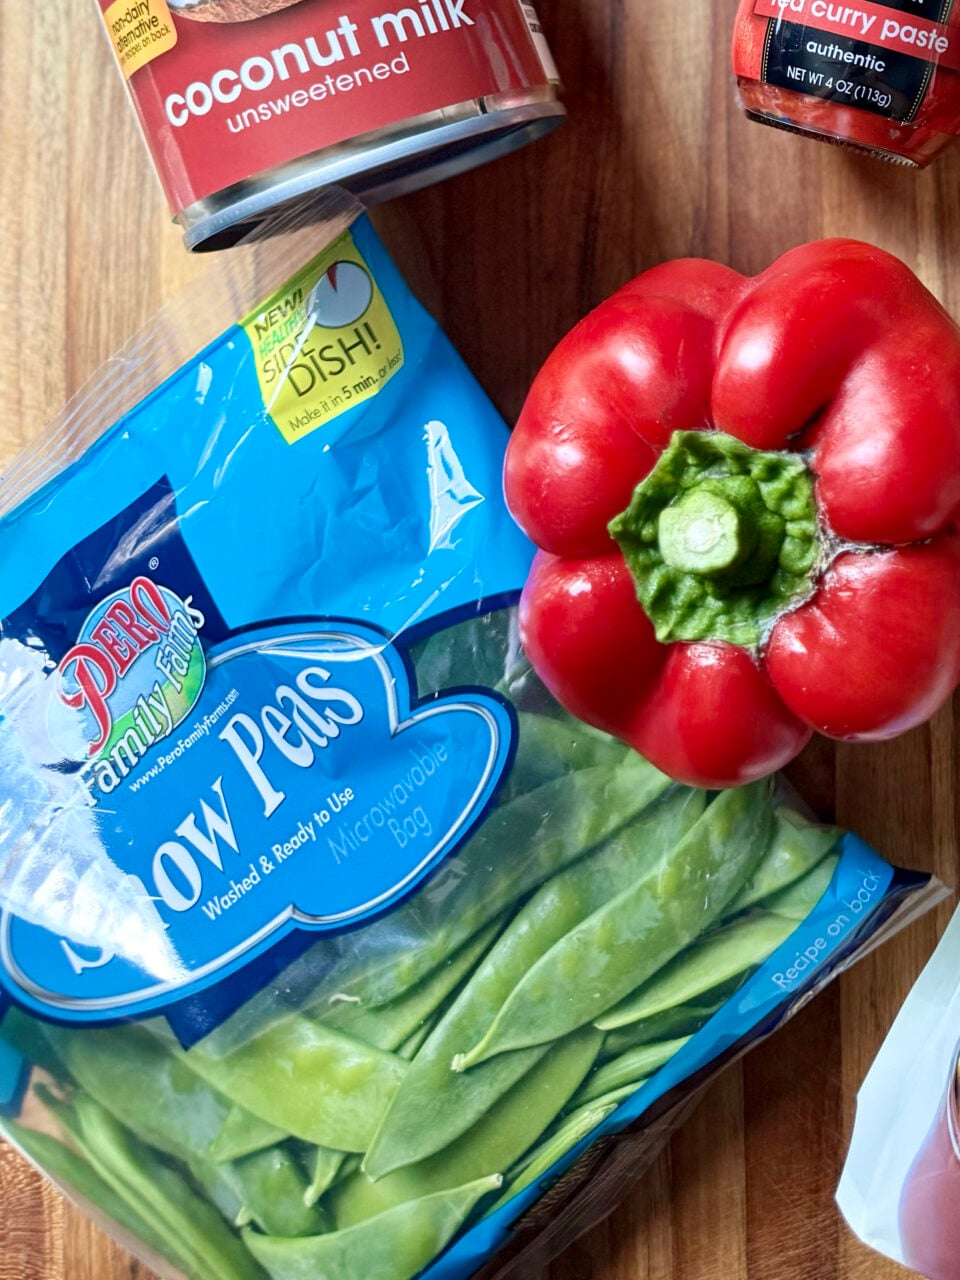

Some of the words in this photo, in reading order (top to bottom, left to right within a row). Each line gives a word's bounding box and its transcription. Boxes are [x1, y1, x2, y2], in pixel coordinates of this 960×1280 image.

[112, 0, 150, 35] non-dairy
[117, 15, 160, 53] alternative
[142, 36, 151, 48] on
[152, 24, 171, 42] back
[811, 0, 877, 35] curry
[880, 19, 949, 54] paste
[164, 15, 361, 128] coconut
[226, 54, 410, 134] unsweetened
[787, 66, 807, 82] NET
[808, 71, 825, 86] WT
[826, 77, 833, 89] 4
[835, 80, 854, 95] OZ
[854, 85, 892, 109] (113g)
[806, 41, 886, 72] authentic
[254, 288, 303, 341] NEW!
[287, 322, 381, 398] DISH!
[289, 408, 322, 432] Make
[321, 401, 331, 413] it
[331, 395, 344, 406] in
[342, 385, 353, 399] 5
[352, 373, 379, 395] min.
[57, 576, 172, 756] PERO
[75, 681, 174, 807] Family
[156, 595, 206, 693] Farms
[128, 688, 240, 793] www.PeroFamilyFarms.com
[218, 666, 365, 819] Peas
[328, 740, 448, 865] Microwavable
[388, 805, 432, 849] Bag
[201, 864, 261, 921] Washed
[259, 855, 275, 875] &
[271, 821, 317, 864] Ready
[313, 808, 330, 828] to
[326, 786, 355, 813] Use
[771, 937, 827, 989] Recipe
[827, 914, 850, 936] on
[842, 869, 882, 914] back
